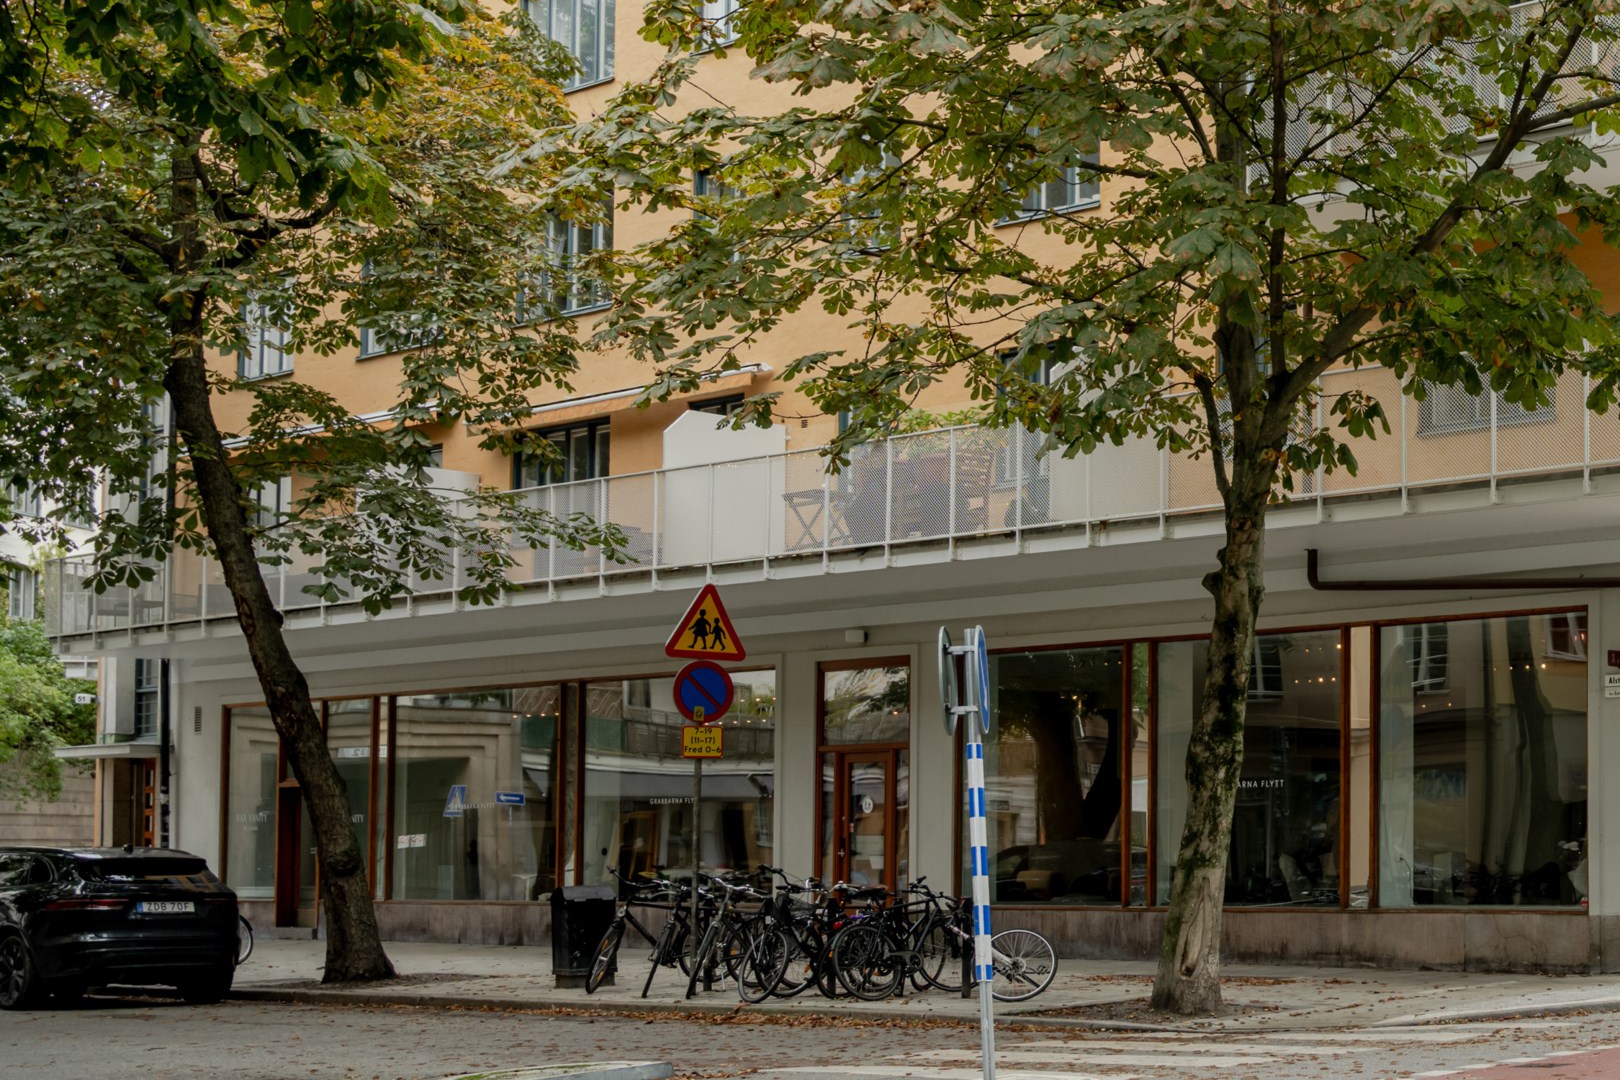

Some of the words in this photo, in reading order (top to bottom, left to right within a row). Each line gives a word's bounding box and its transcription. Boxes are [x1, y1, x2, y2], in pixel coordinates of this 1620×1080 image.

[77, 695, 86, 703] 51
[694, 727, 713, 735] 7-19
[690, 736, 716, 744] (11-17)
[684, 745, 703, 753] Fred
[705, 745, 722, 753] 0-6
[1260, 779, 1285, 788] FLYTT
[147, 902, 167, 911] ZDB
[171, 902, 189, 911] 70F
